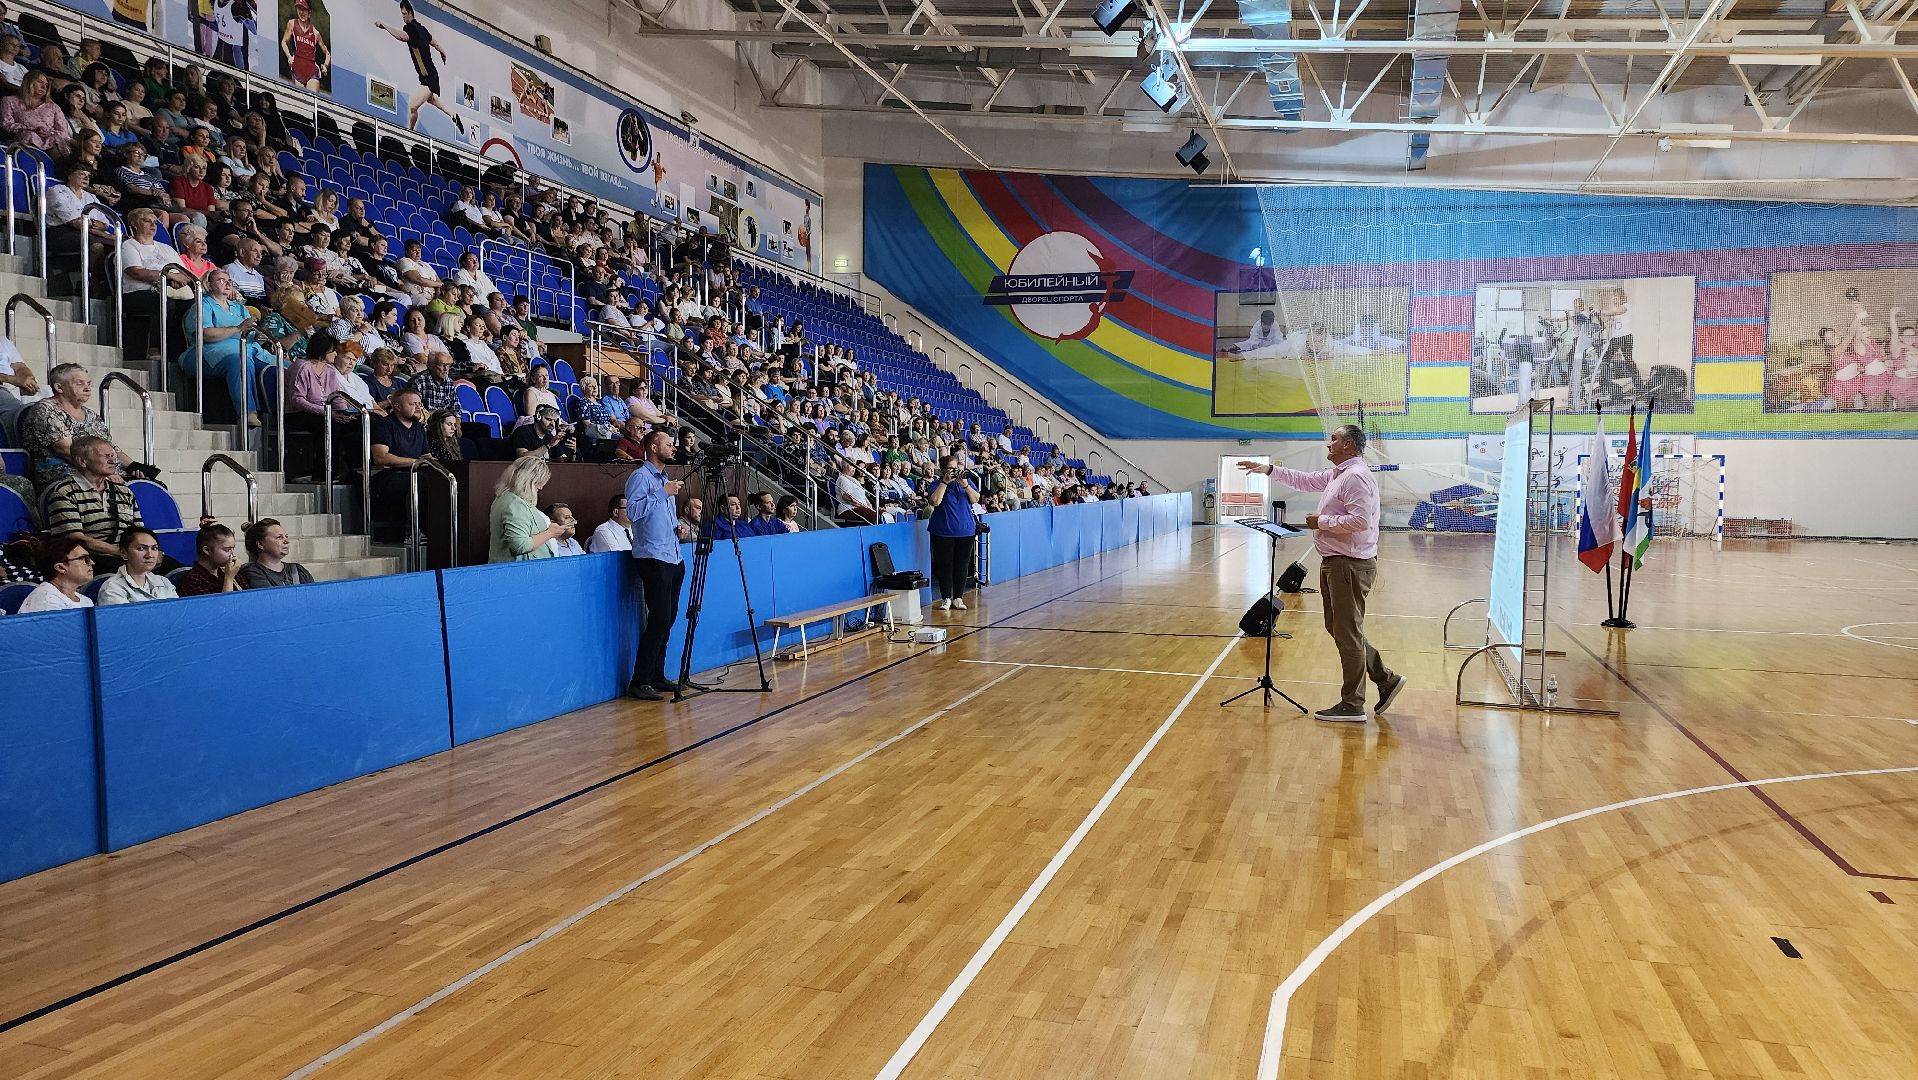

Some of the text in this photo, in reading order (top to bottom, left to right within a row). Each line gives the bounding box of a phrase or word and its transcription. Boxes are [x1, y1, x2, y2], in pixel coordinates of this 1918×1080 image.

[296, 35, 315, 48] RUSSIA
[526, 142, 546, 159] ТВОЯ
[581, 163, 599, 180] ТВОЙ
[1005, 274, 1099, 288] ЮБИЛЕЙНЫЙ
